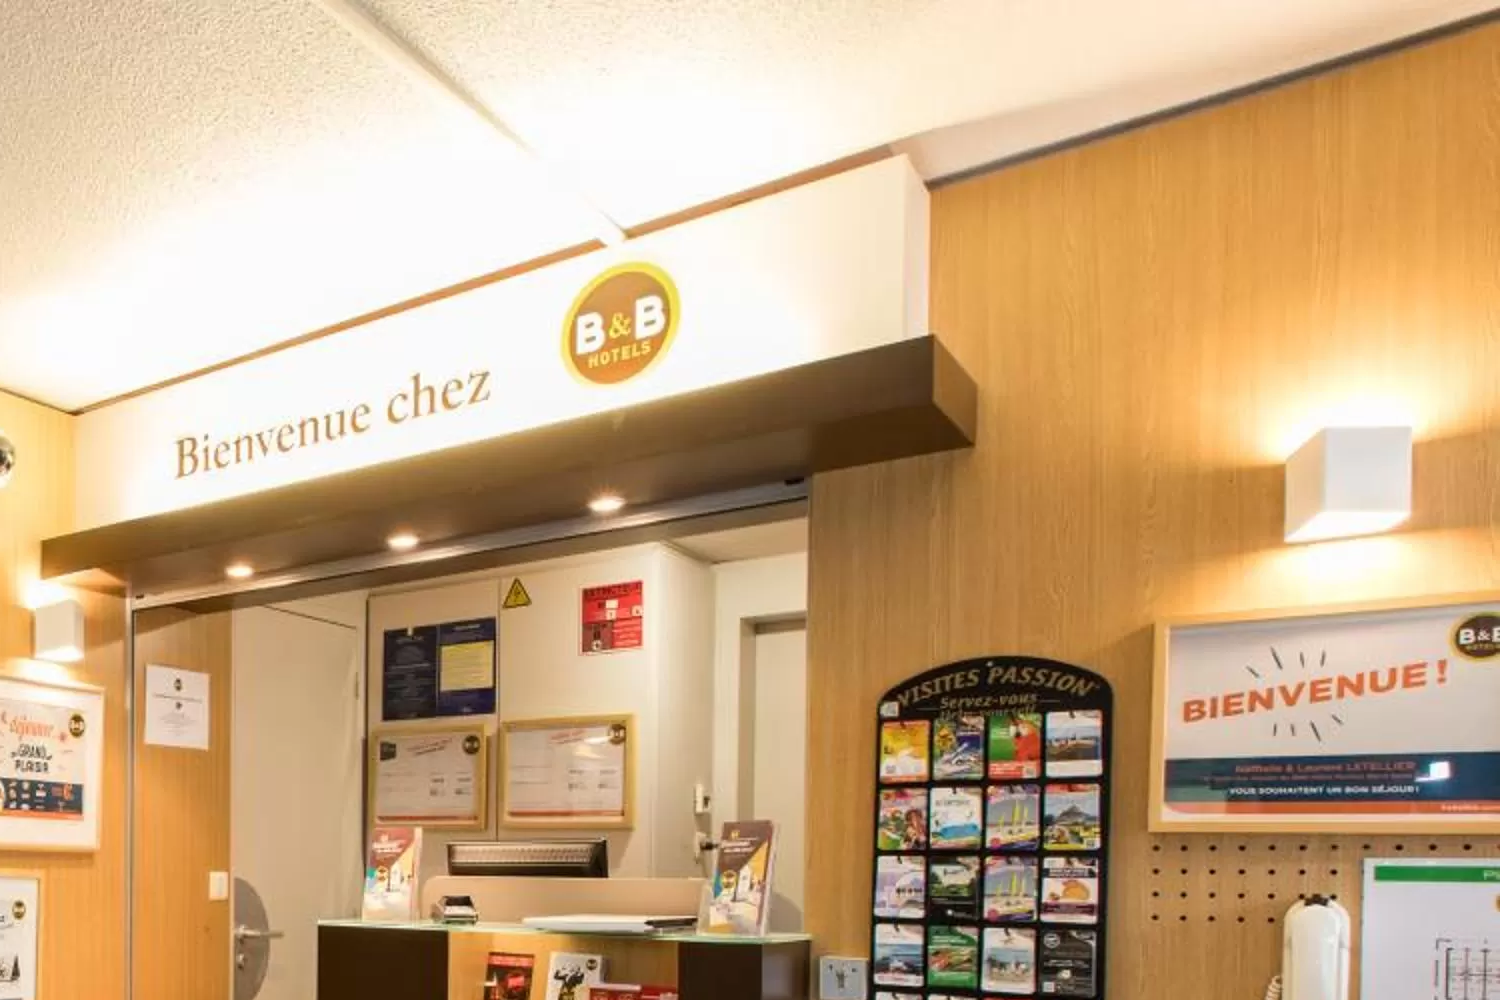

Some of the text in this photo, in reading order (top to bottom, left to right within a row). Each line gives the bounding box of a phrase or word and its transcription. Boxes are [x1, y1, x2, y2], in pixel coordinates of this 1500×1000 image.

[575, 294, 666, 355] B&B
[587, 340, 652, 369] HOTELS
[174, 368, 492, 479] Bienvenue chez
[897, 665, 1094, 707] VISITES PASSION
[939, 692, 1038, 710] Servez-vous
[1182, 658, 1448, 723] BIENVENUE !
